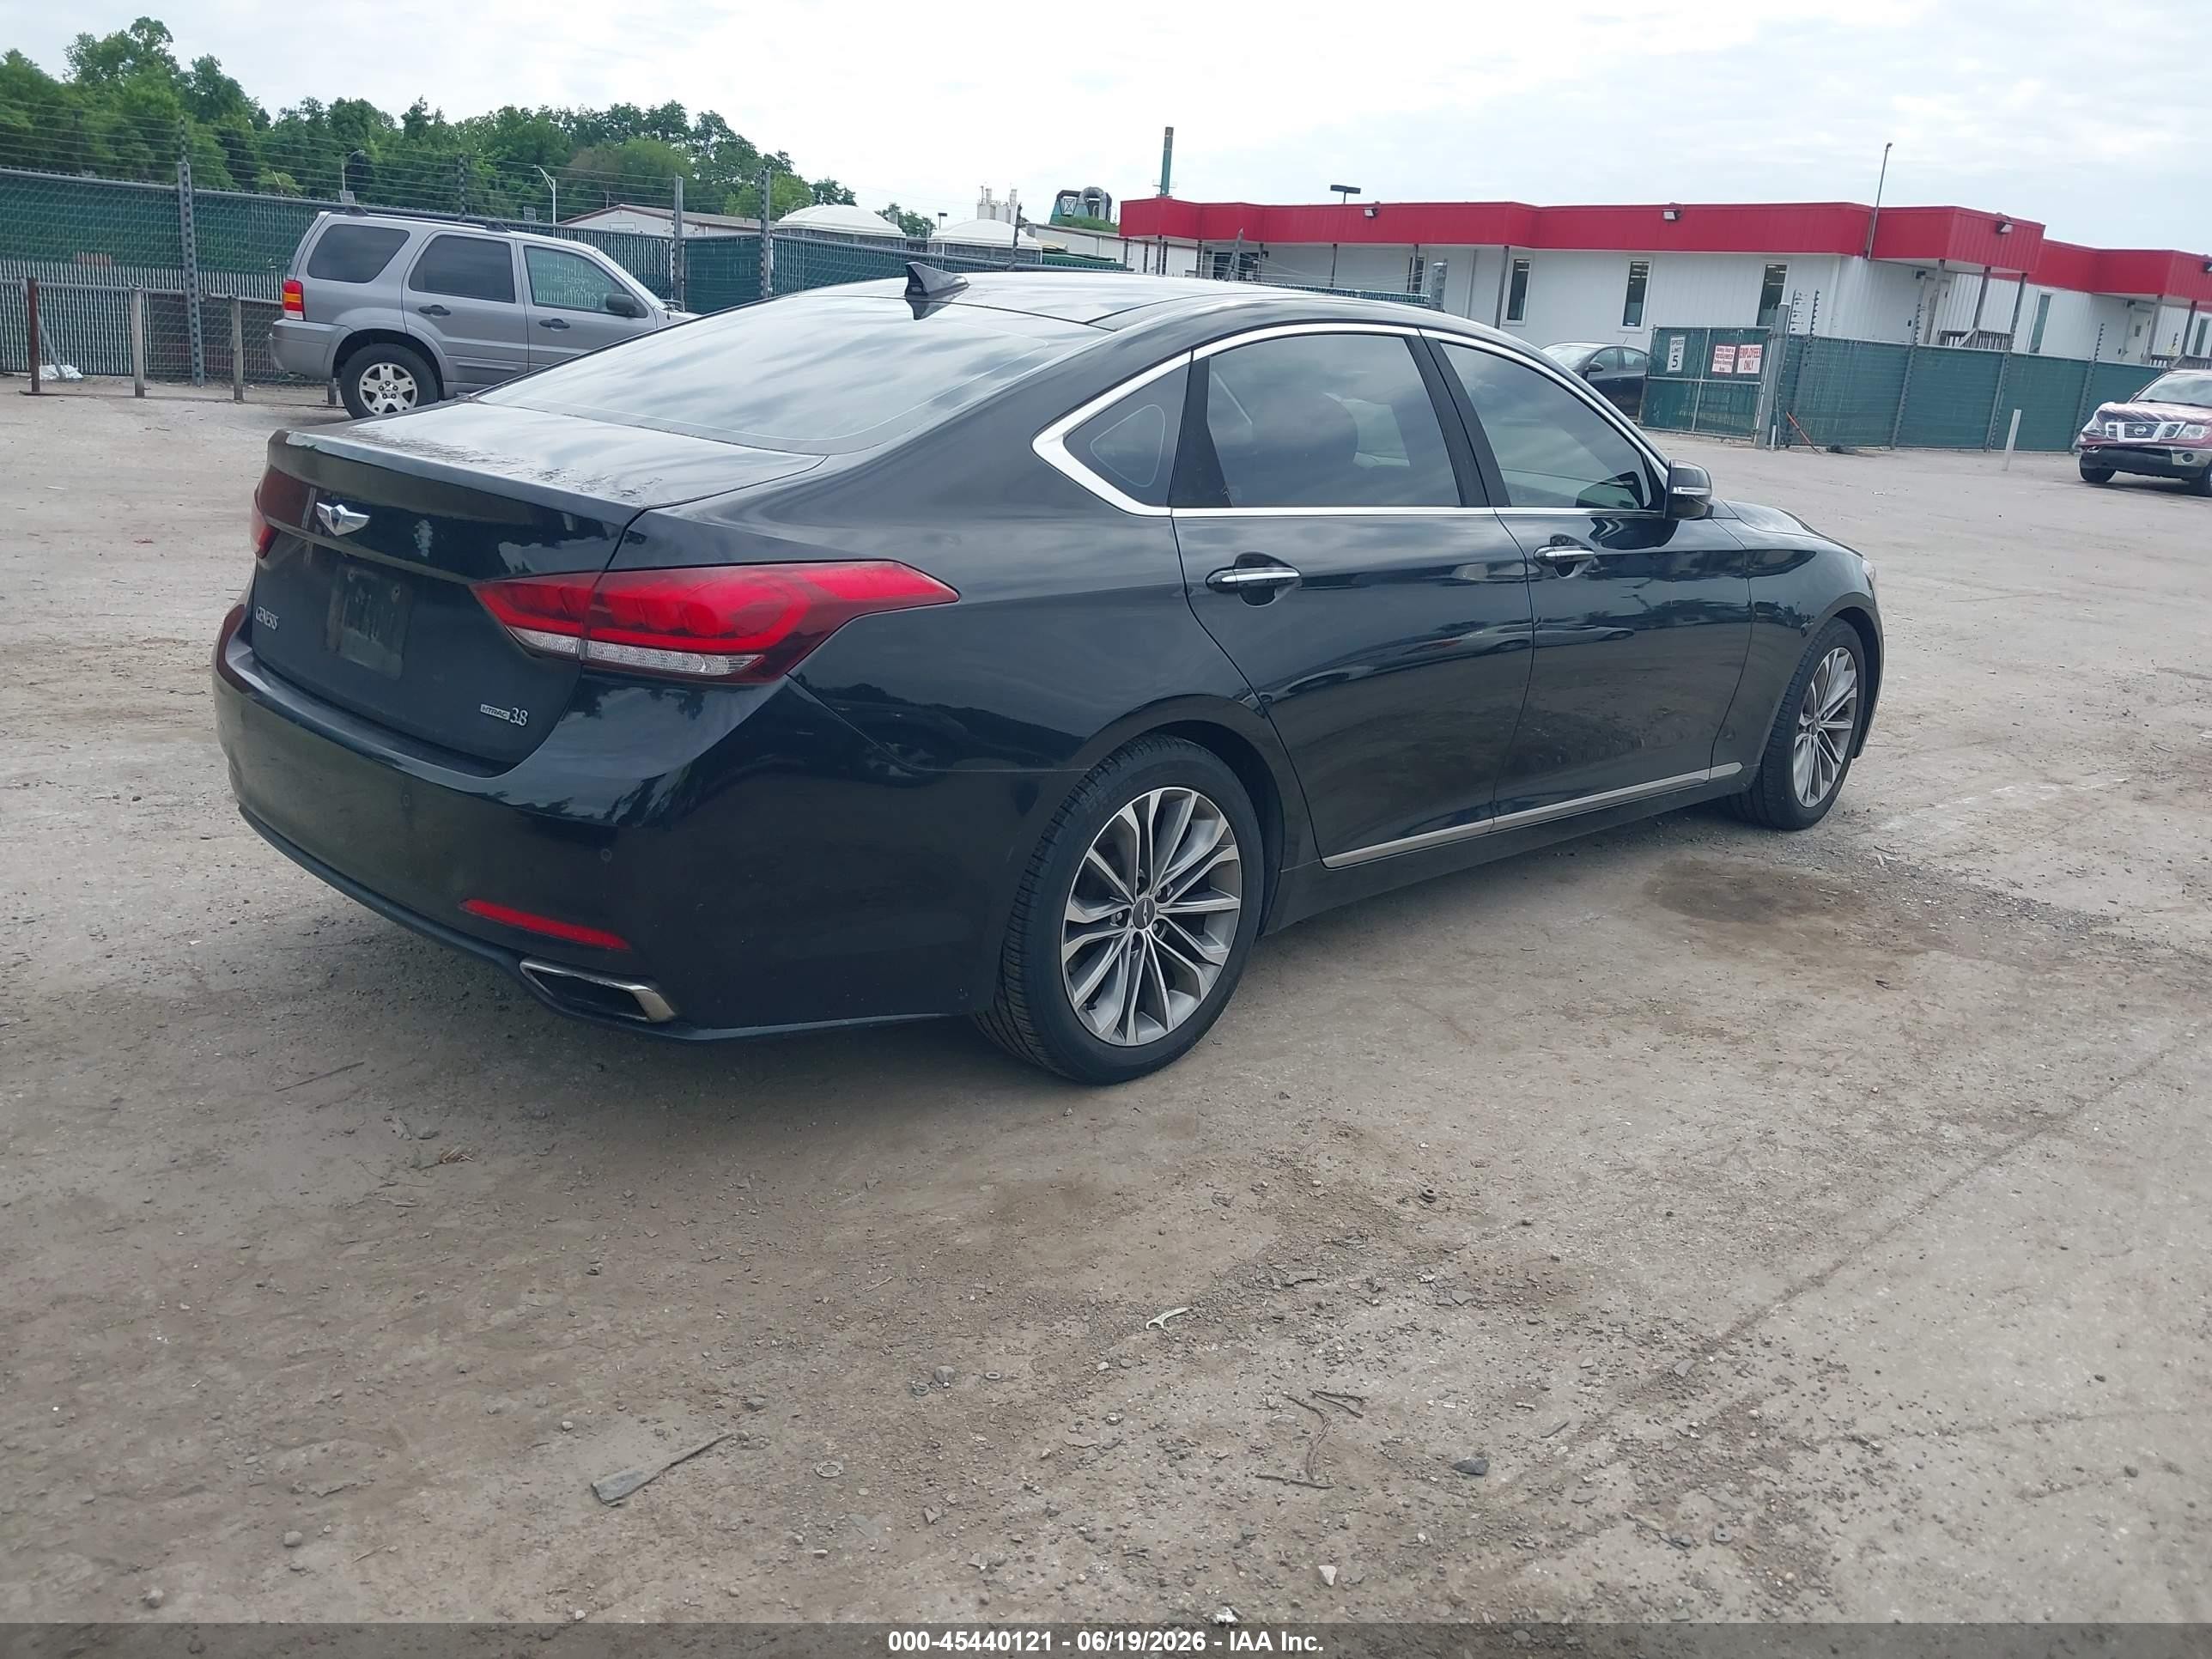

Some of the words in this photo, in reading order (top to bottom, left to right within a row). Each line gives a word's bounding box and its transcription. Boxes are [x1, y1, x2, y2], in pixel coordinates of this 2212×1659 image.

[1740, 347, 1761, 358] EMPLOYEES
[1672, 355, 1679, 368] 5
[1744, 359, 1754, 370] ONLY
[481, 704, 510, 720] HTRAC
